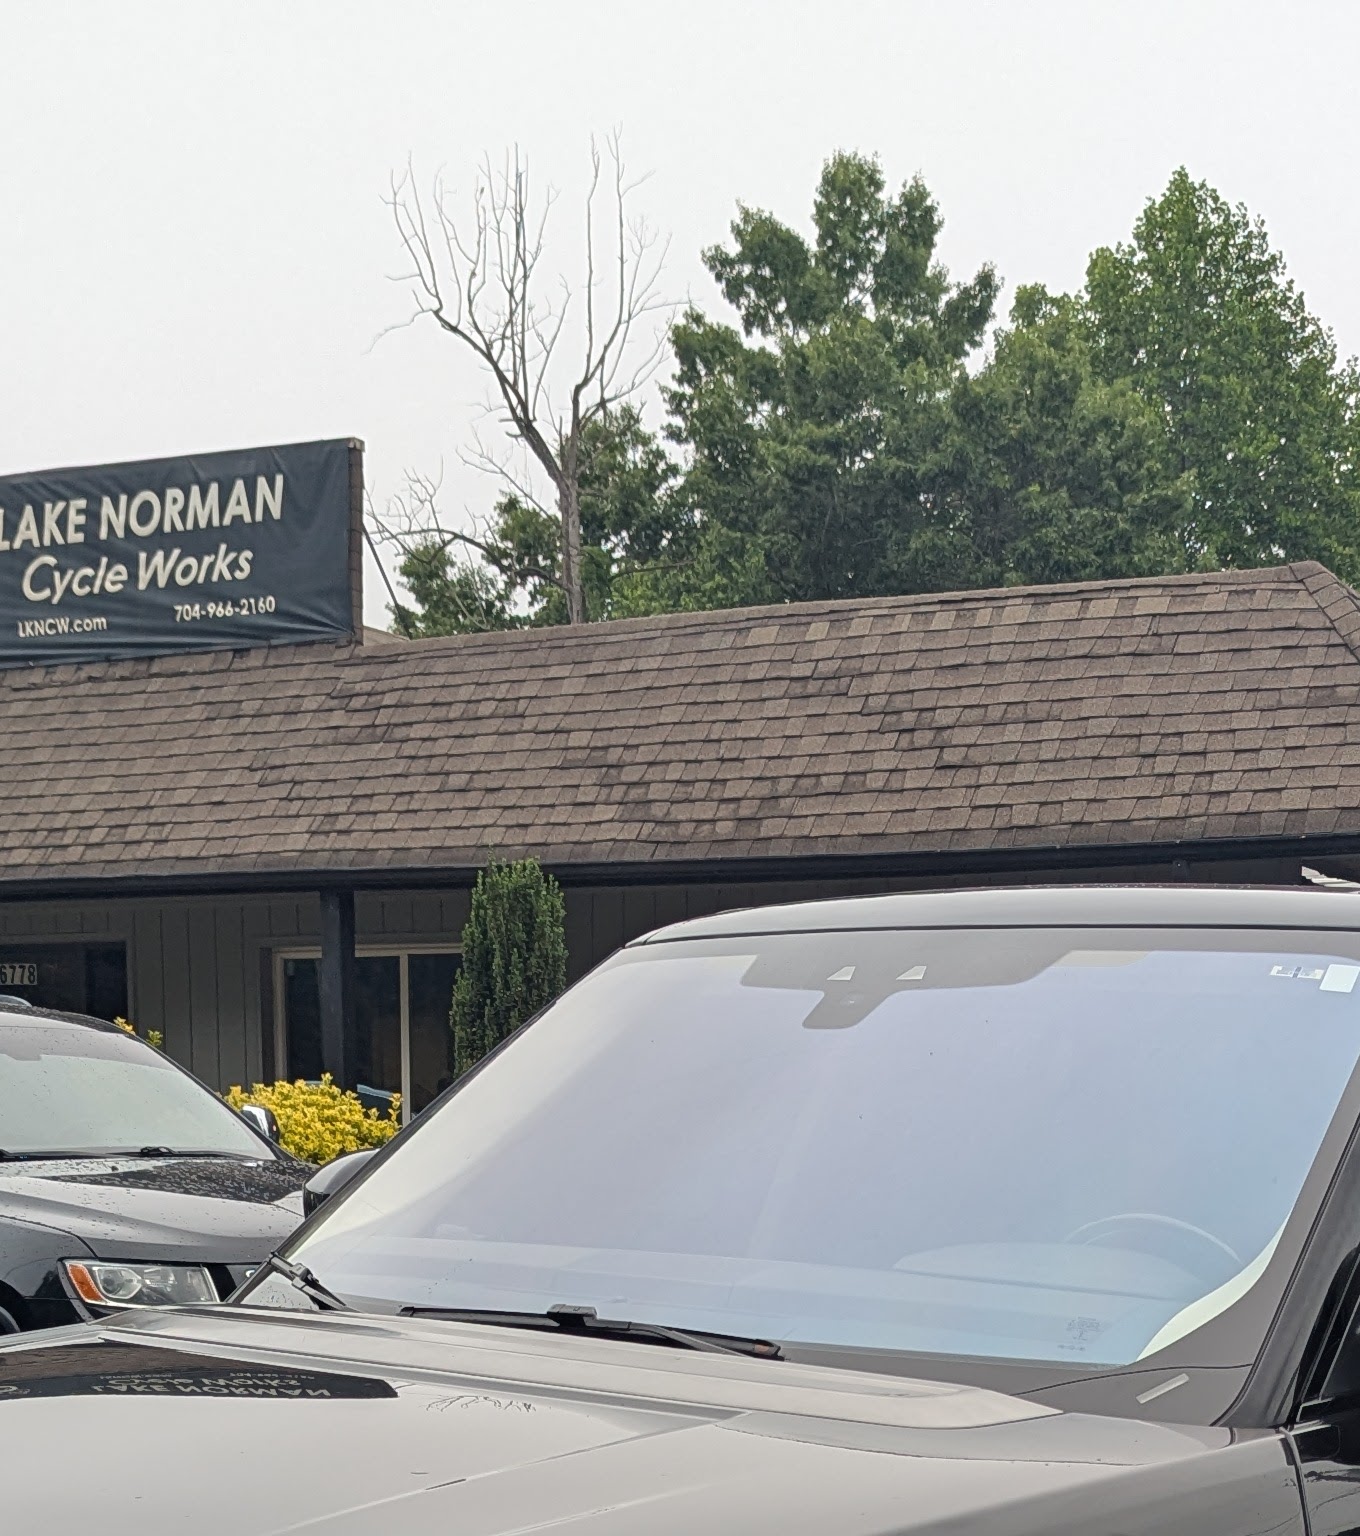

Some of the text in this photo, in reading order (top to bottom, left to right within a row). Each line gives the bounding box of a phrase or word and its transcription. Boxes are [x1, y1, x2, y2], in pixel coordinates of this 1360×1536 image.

[98, 473, 284, 540] NORMAN
[21, 542, 254, 605] Cycle Works
[174, 595, 276, 622] 704-966-2160
[17, 616, 108, 638] LKNCW.com
[0, 964, 36, 984] 6778
